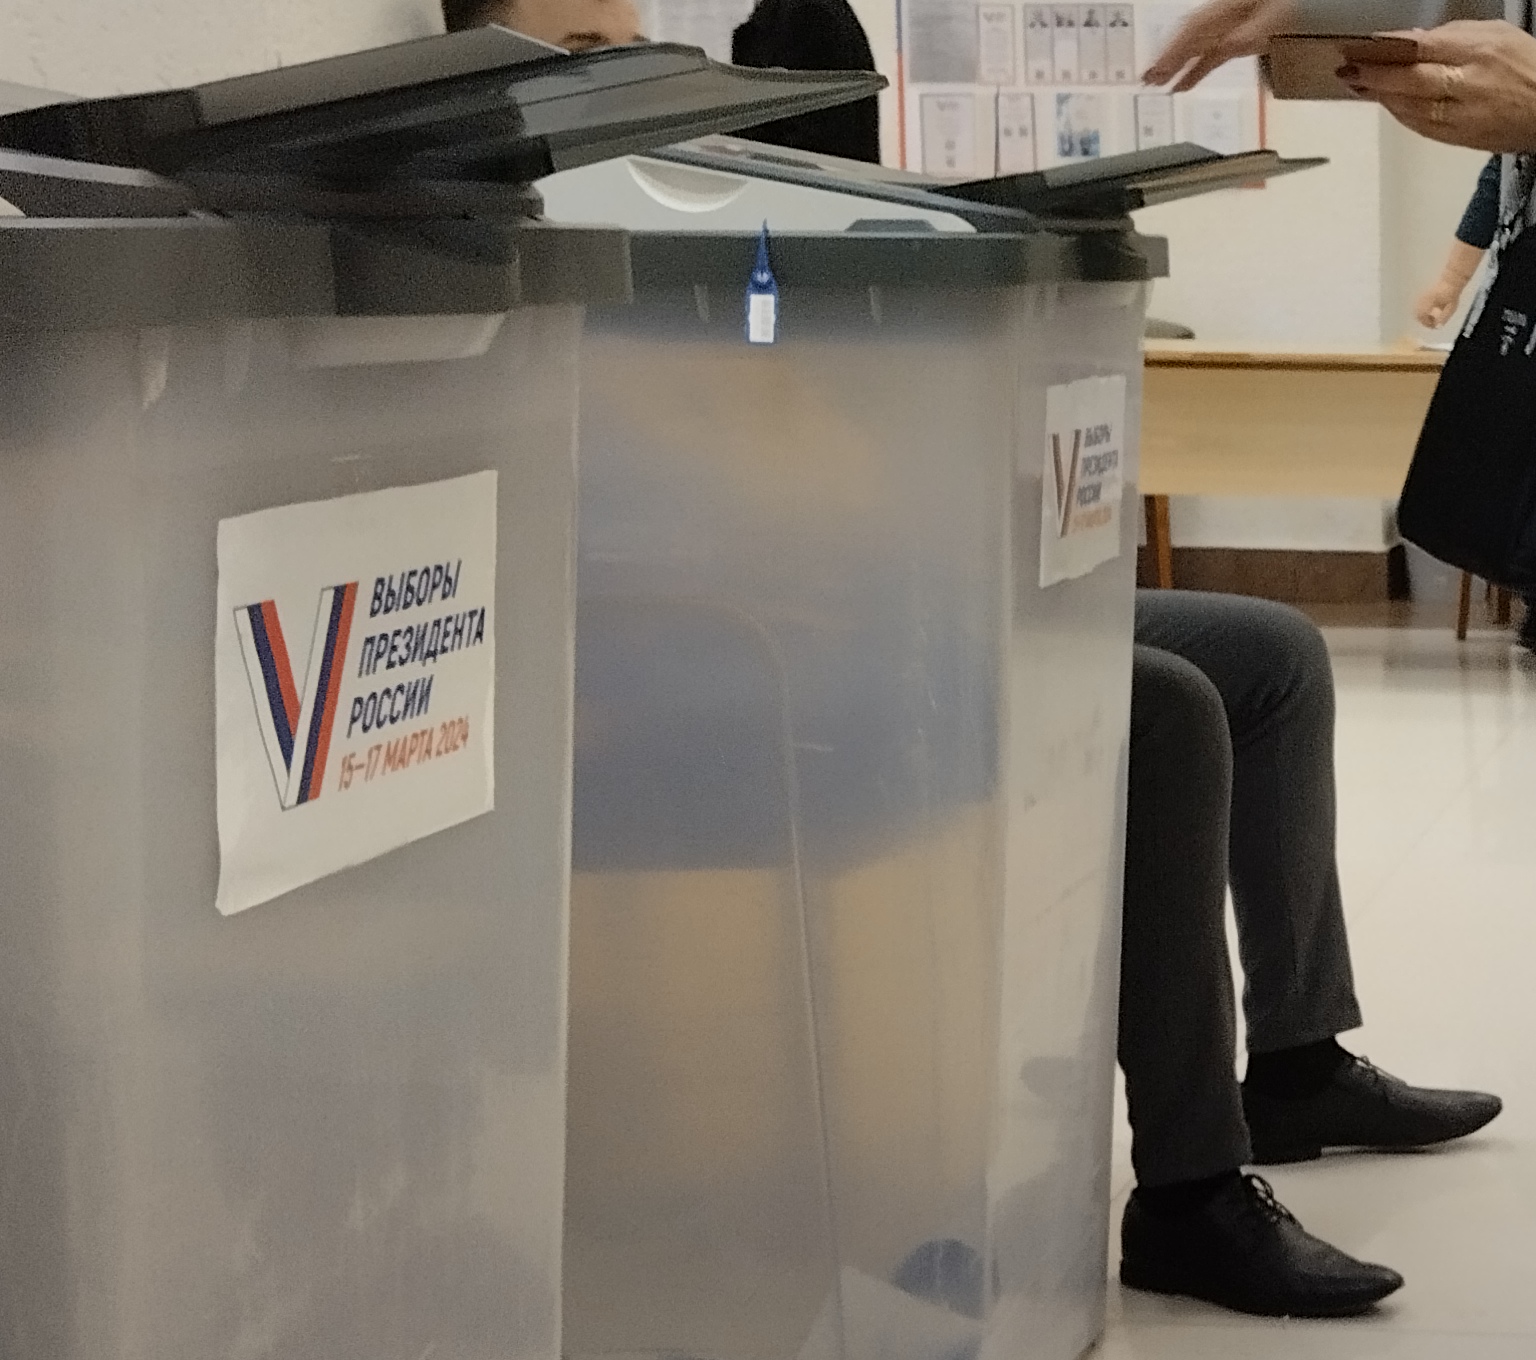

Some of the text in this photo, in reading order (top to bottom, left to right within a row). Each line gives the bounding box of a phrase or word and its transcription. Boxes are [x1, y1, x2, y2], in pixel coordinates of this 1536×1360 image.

[369, 559, 462, 619] ВЫБОРЫ
[357, 606, 485, 678] ПРЕЗИДЕНТА
[346, 674, 434, 739] РОССИИ
[381, 728, 435, 776] МАРТА
[435, 715, 470, 757] 2024
